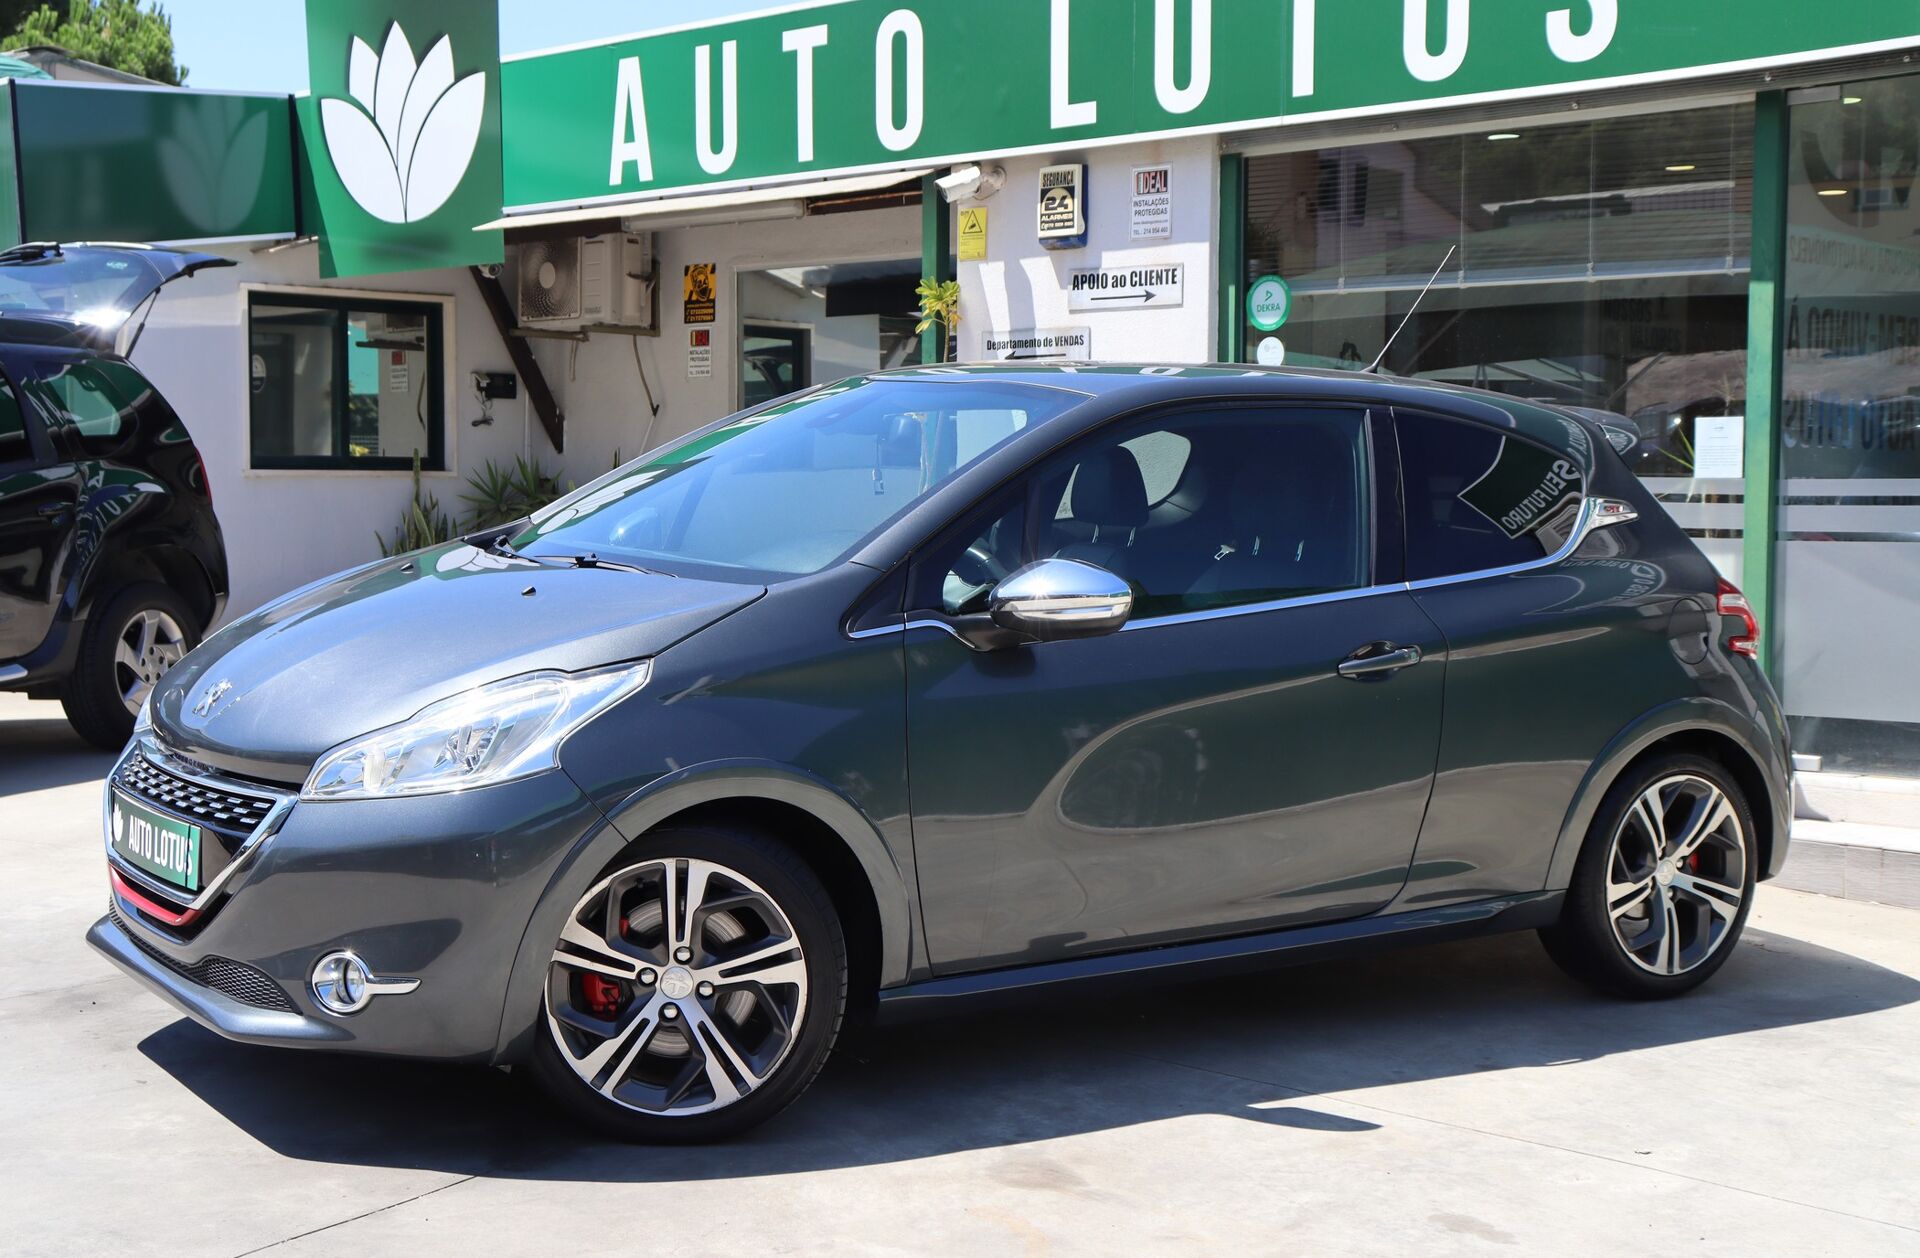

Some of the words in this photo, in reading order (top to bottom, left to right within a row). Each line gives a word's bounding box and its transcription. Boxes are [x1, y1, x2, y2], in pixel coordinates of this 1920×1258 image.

[609, 9, 924, 186] AUTO
[1136, 171, 1167, 194] IDEAL
[1044, 195, 1069, 211] 24
[1133, 197, 1169, 207] INSTALAÇÕES
[1134, 208, 1168, 217] PROTEGIDAS
[1072, 272, 1109, 290] APOIO
[1111, 274, 1126, 289] ao
[1130, 268, 1178, 287] CLIENTE
[1256, 303, 1281, 312] DEKRA
[986, 338, 1042, 350] Departamento
[1042, 336, 1054, 347] de
[1054, 335, 1084, 346] VENDAS
[129, 815, 152, 860] AUTO
[154, 826, 194, 876] LOTUS
